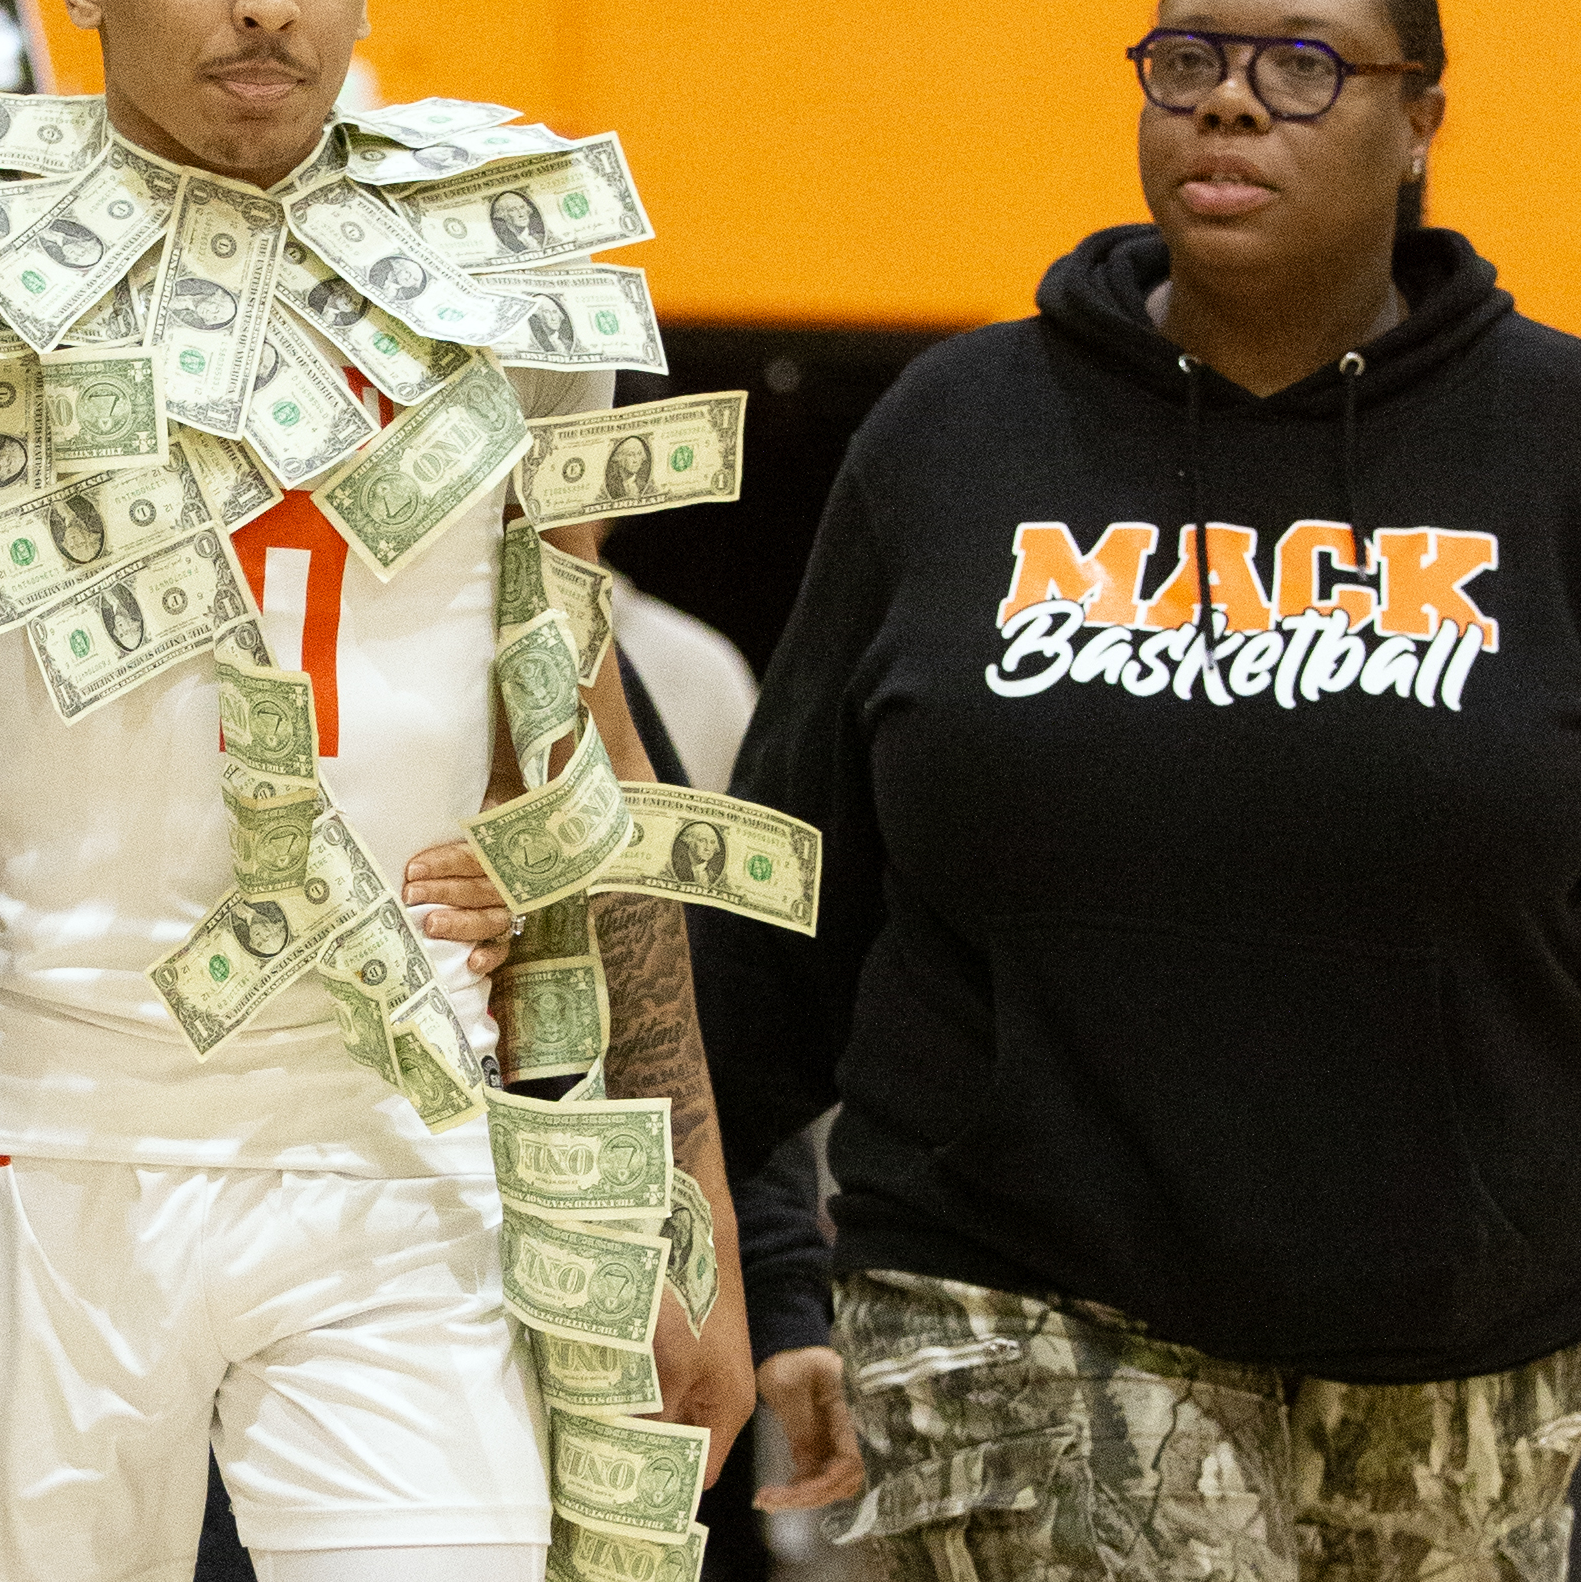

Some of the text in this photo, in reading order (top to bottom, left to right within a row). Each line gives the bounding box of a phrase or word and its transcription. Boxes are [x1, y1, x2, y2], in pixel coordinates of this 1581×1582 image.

[414, 425, 484, 484] ONE
[17, 583, 61, 607] AMERICA
[996, 520, 1500, 653] MACK
[125, 649, 155, 671] STATES
[152, 633, 188, 656] UNITED
[985, 597, 1486, 712] Basketball
[79, 671, 118, 698] AMERICA
[681, 883, 741, 904] DOLLAR
[520, 1138, 595, 1176] ONE
[520, 1242, 588, 1295] ONE
[560, 1433, 636, 1492] ONE
